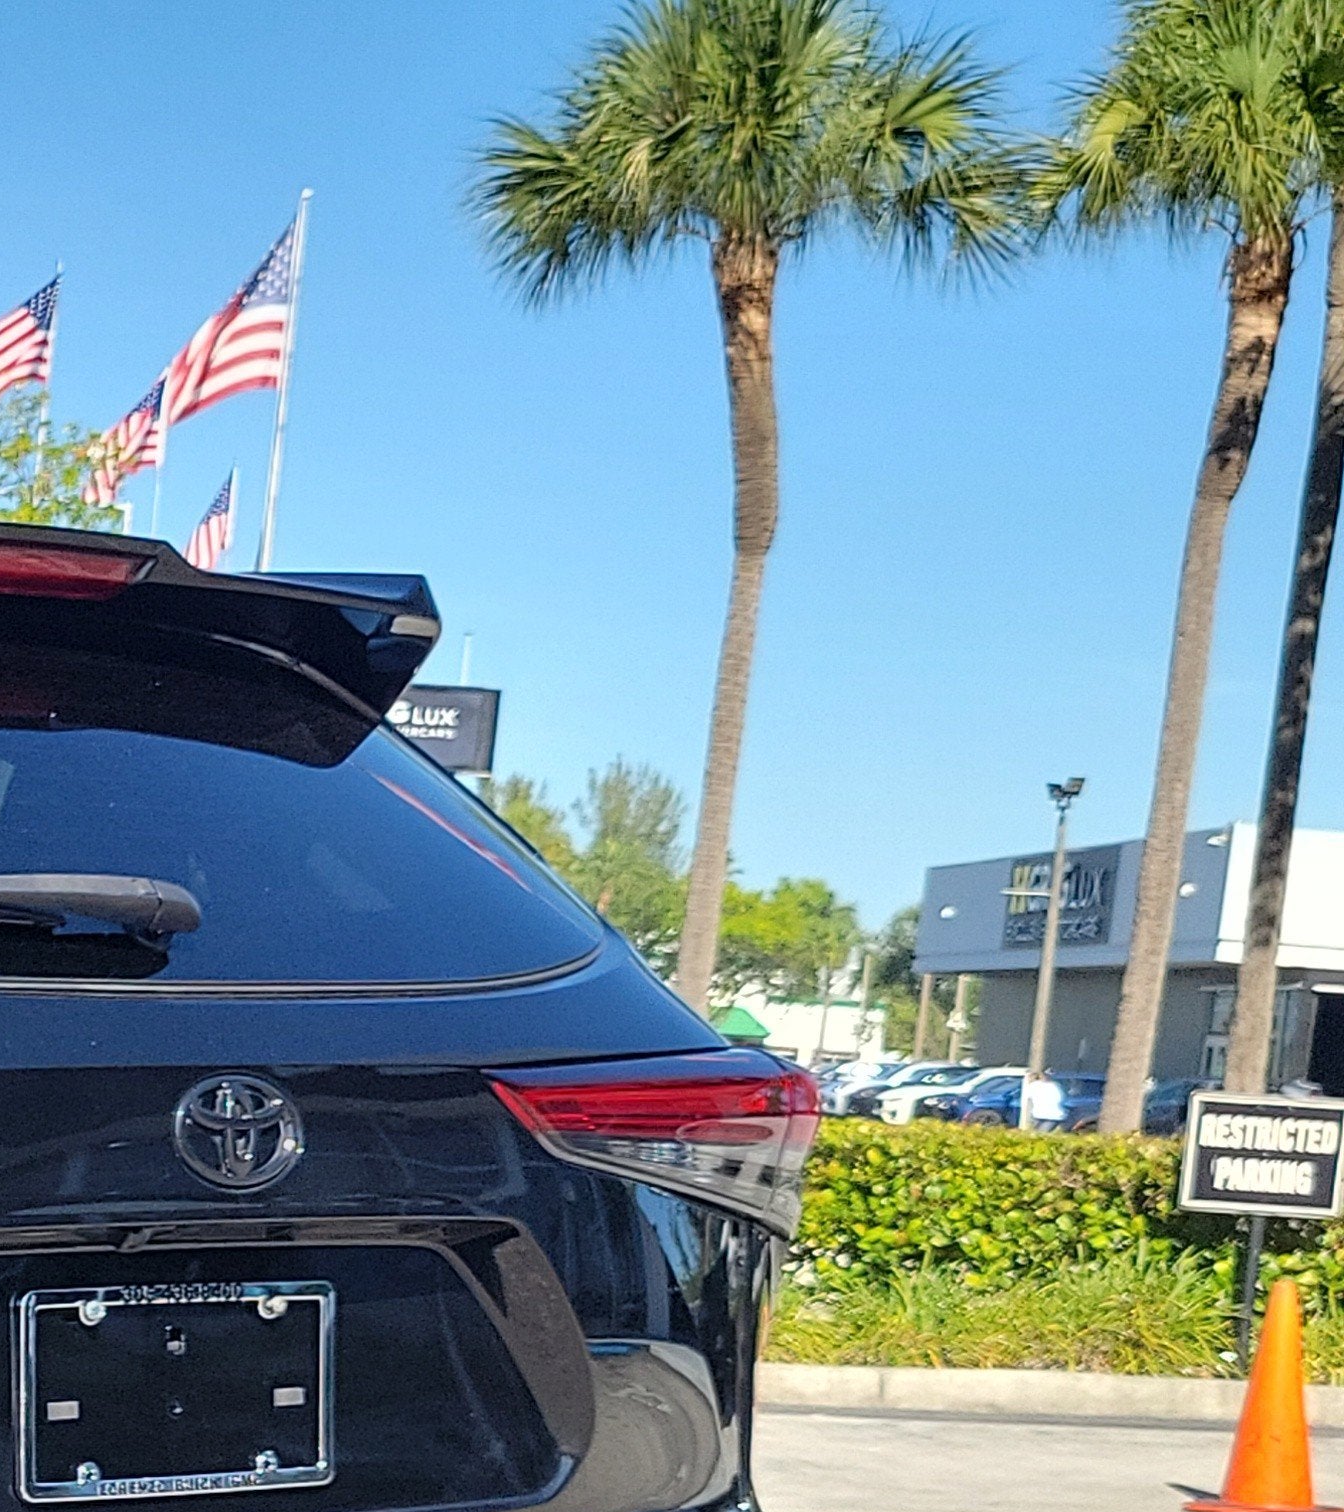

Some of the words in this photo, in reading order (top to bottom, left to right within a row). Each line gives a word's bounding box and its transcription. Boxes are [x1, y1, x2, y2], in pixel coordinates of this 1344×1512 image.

[411, 705, 461, 728] LUX
[1198, 1112, 1340, 1155] RESTRICTED
[1211, 1156, 1315, 1197] PARKING
